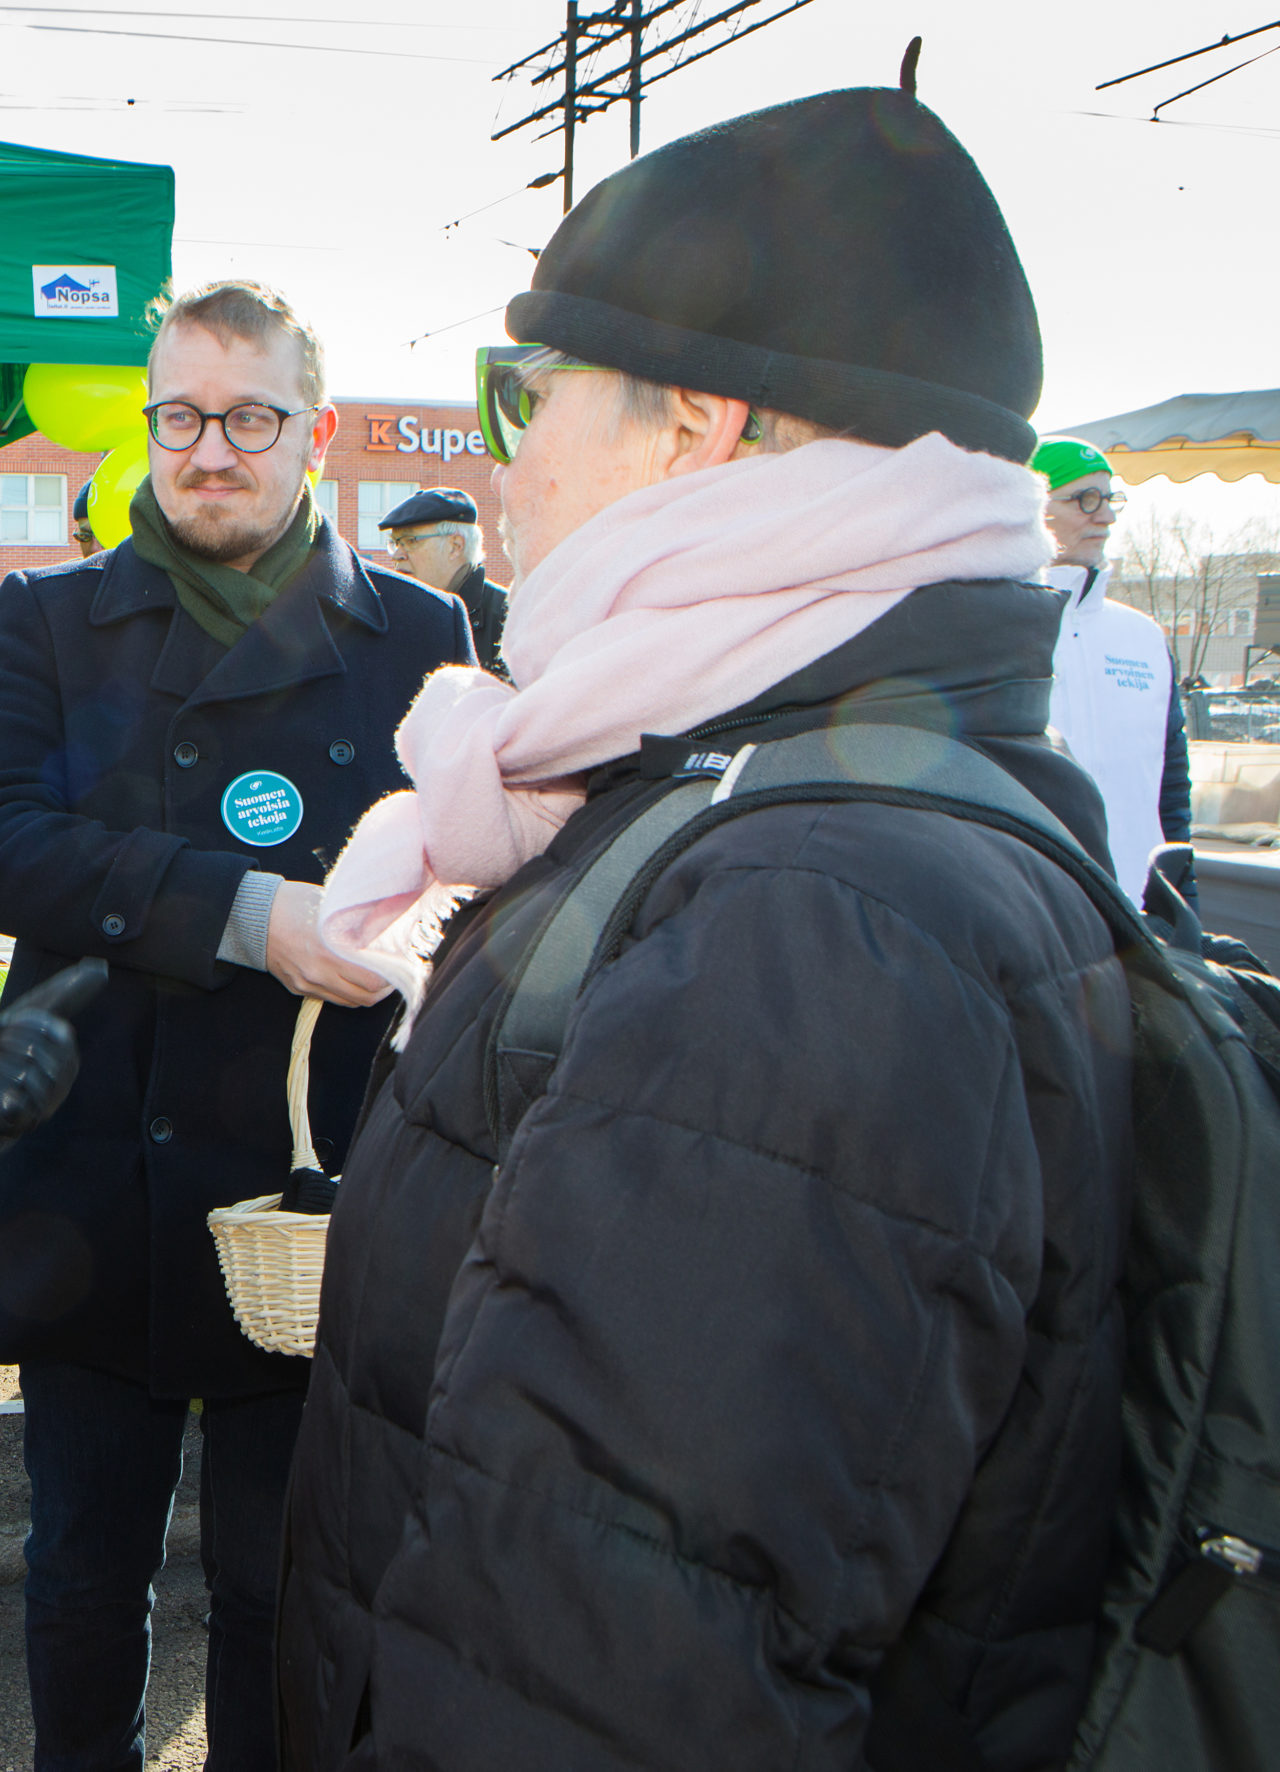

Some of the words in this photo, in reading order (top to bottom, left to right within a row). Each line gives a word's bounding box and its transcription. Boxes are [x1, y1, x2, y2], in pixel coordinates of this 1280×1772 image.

[57, 287, 110, 304] Nopsa
[397, 415, 488, 463] Supe
[234, 788, 287, 809] Suomen
[247, 810, 288, 829] tekoja
